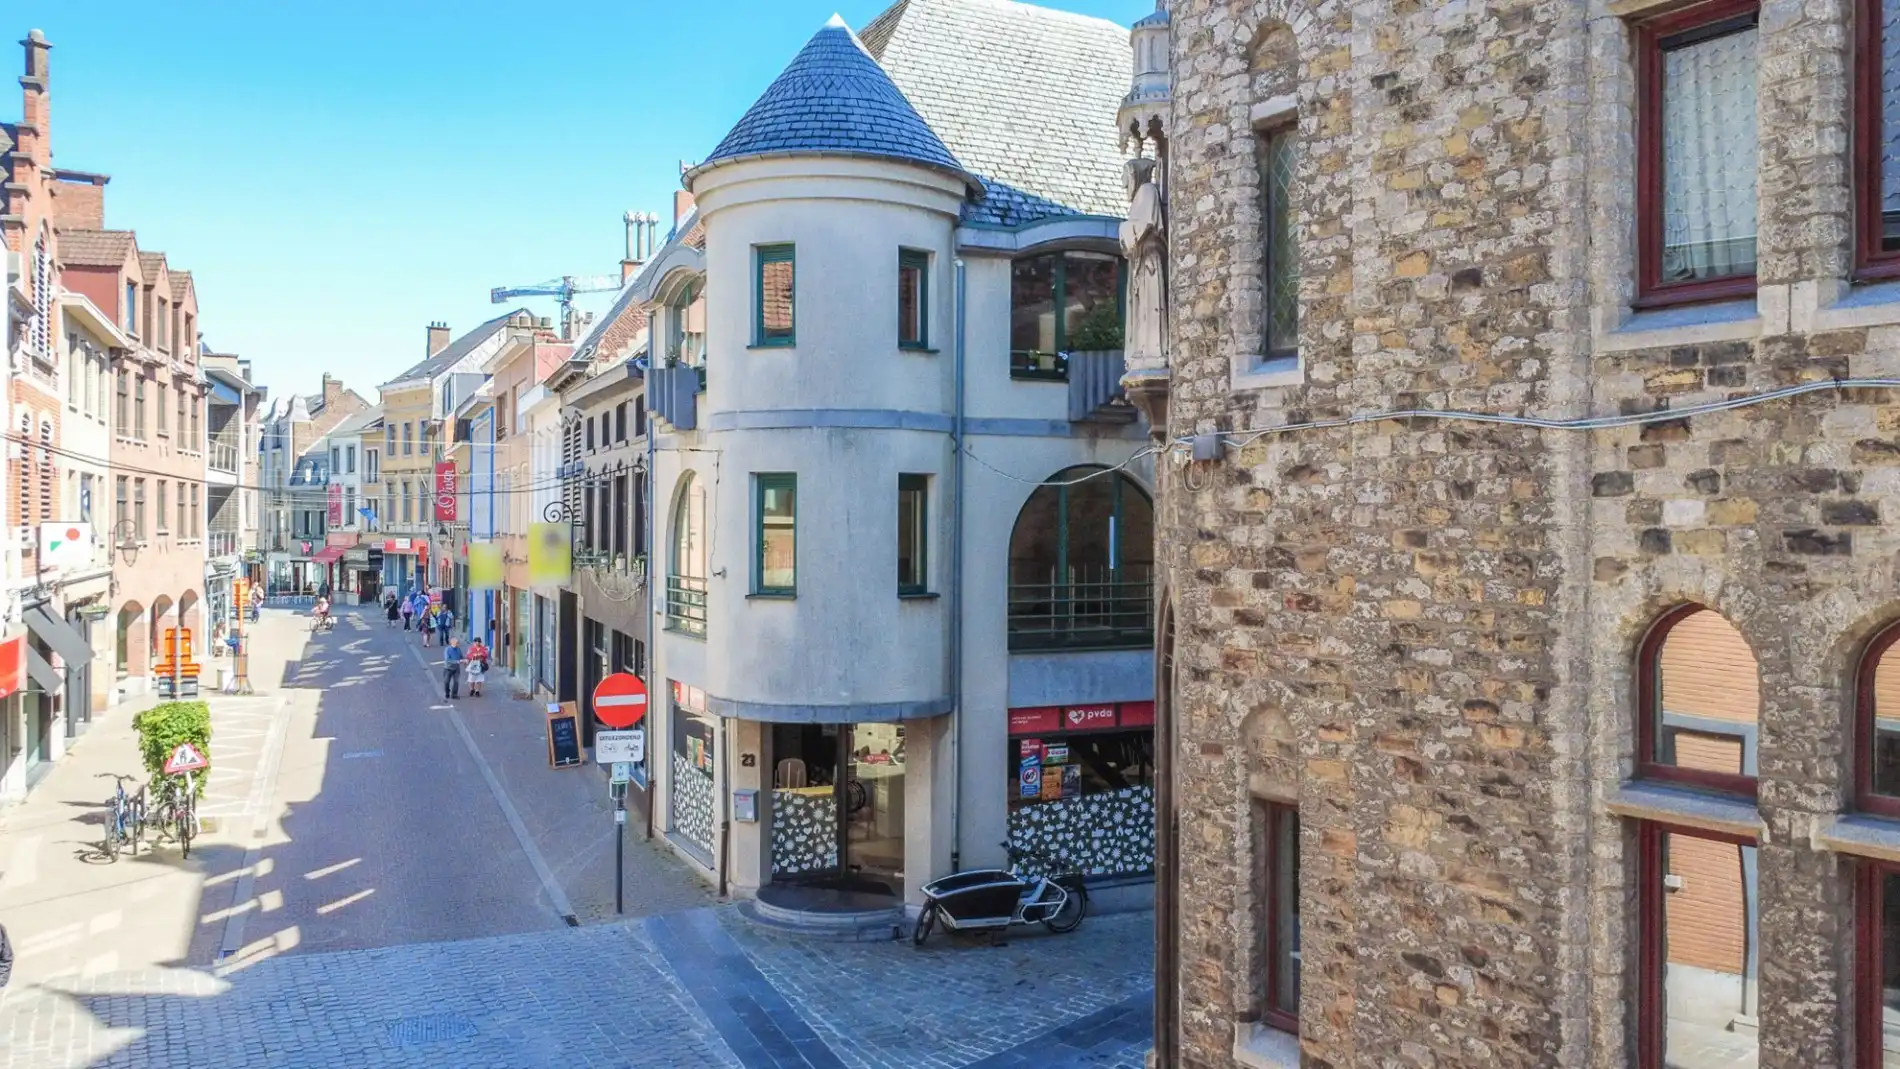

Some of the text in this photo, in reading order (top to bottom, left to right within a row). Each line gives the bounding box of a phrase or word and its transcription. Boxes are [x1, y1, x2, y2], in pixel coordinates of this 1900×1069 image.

[438, 470, 455, 515] s.Oliver
[1087, 708, 1112, 720] pvda
[741, 753, 756, 767] 23
